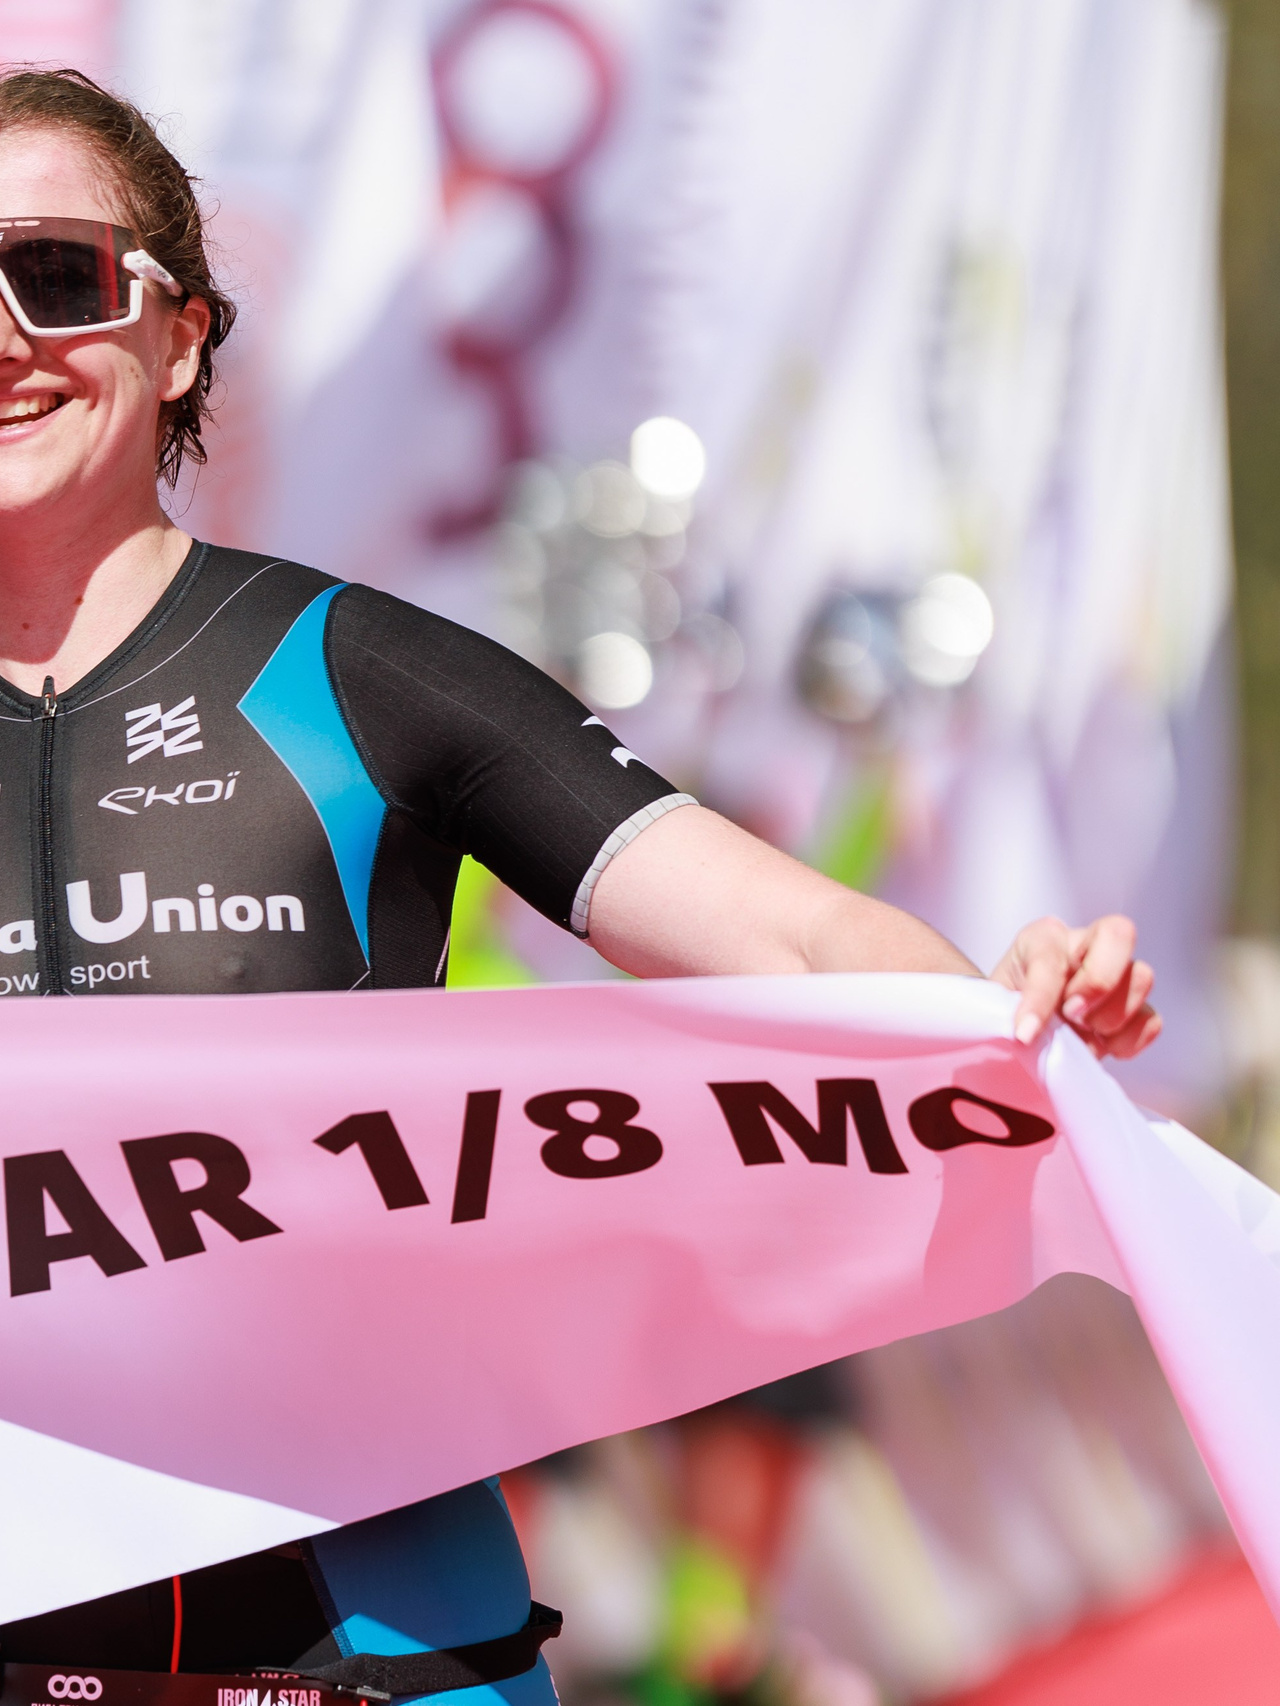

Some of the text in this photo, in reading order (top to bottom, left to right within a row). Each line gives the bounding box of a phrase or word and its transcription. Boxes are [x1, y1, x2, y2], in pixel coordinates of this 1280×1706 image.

[66, 871, 305, 945] Union
[70, 955, 151, 988] sport
[312, 1087, 664, 1225] 1/8
